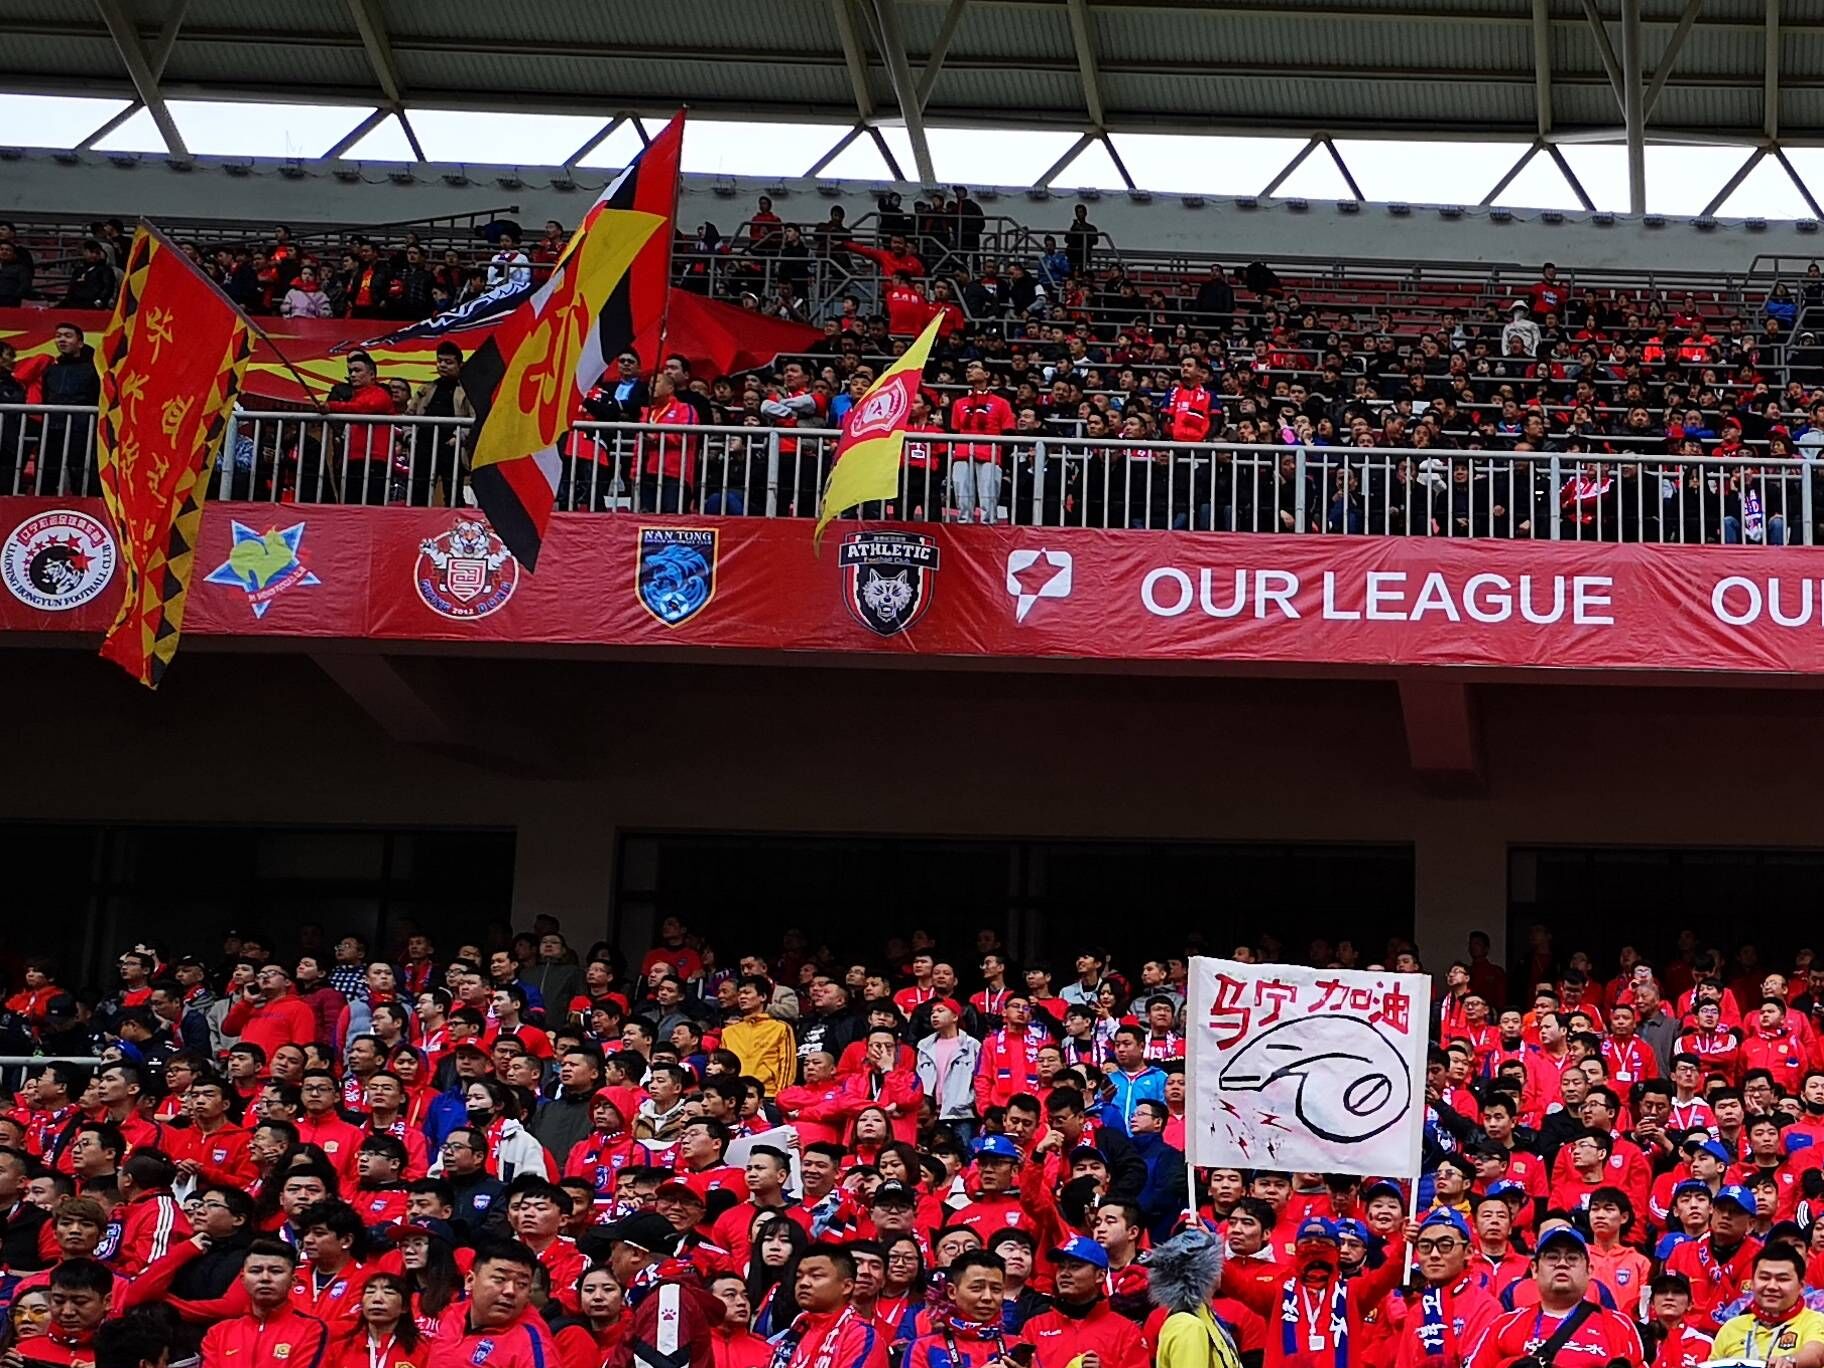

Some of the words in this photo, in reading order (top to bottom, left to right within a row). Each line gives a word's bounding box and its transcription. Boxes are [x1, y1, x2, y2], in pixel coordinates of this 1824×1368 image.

[645, 530, 673, 540] NAN
[676, 531, 712, 541] TONG
[847, 543, 931, 560] ATHLETIC
[1141, 566, 1301, 619] OUR
[1322, 571, 1614, 625] LEAGUE
